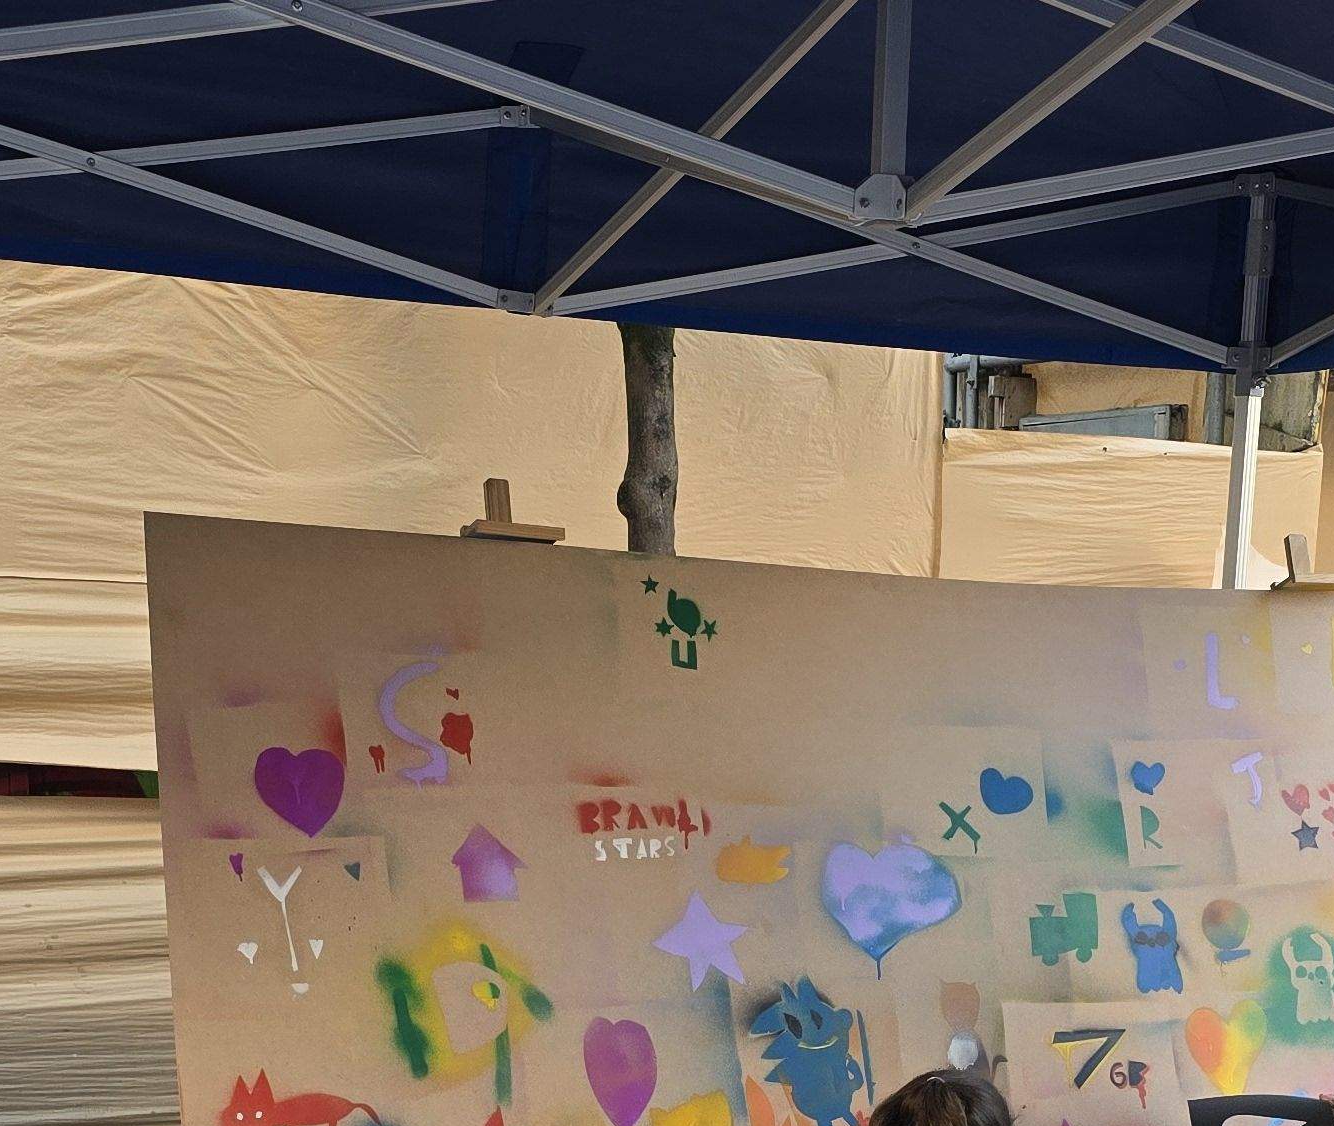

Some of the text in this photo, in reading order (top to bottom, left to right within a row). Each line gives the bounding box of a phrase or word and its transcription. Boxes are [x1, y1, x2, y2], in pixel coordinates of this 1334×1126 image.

[594, 836, 675, 861] STARS
[1140, 805, 1164, 850] R
[1052, 1029, 1126, 1089] 7
